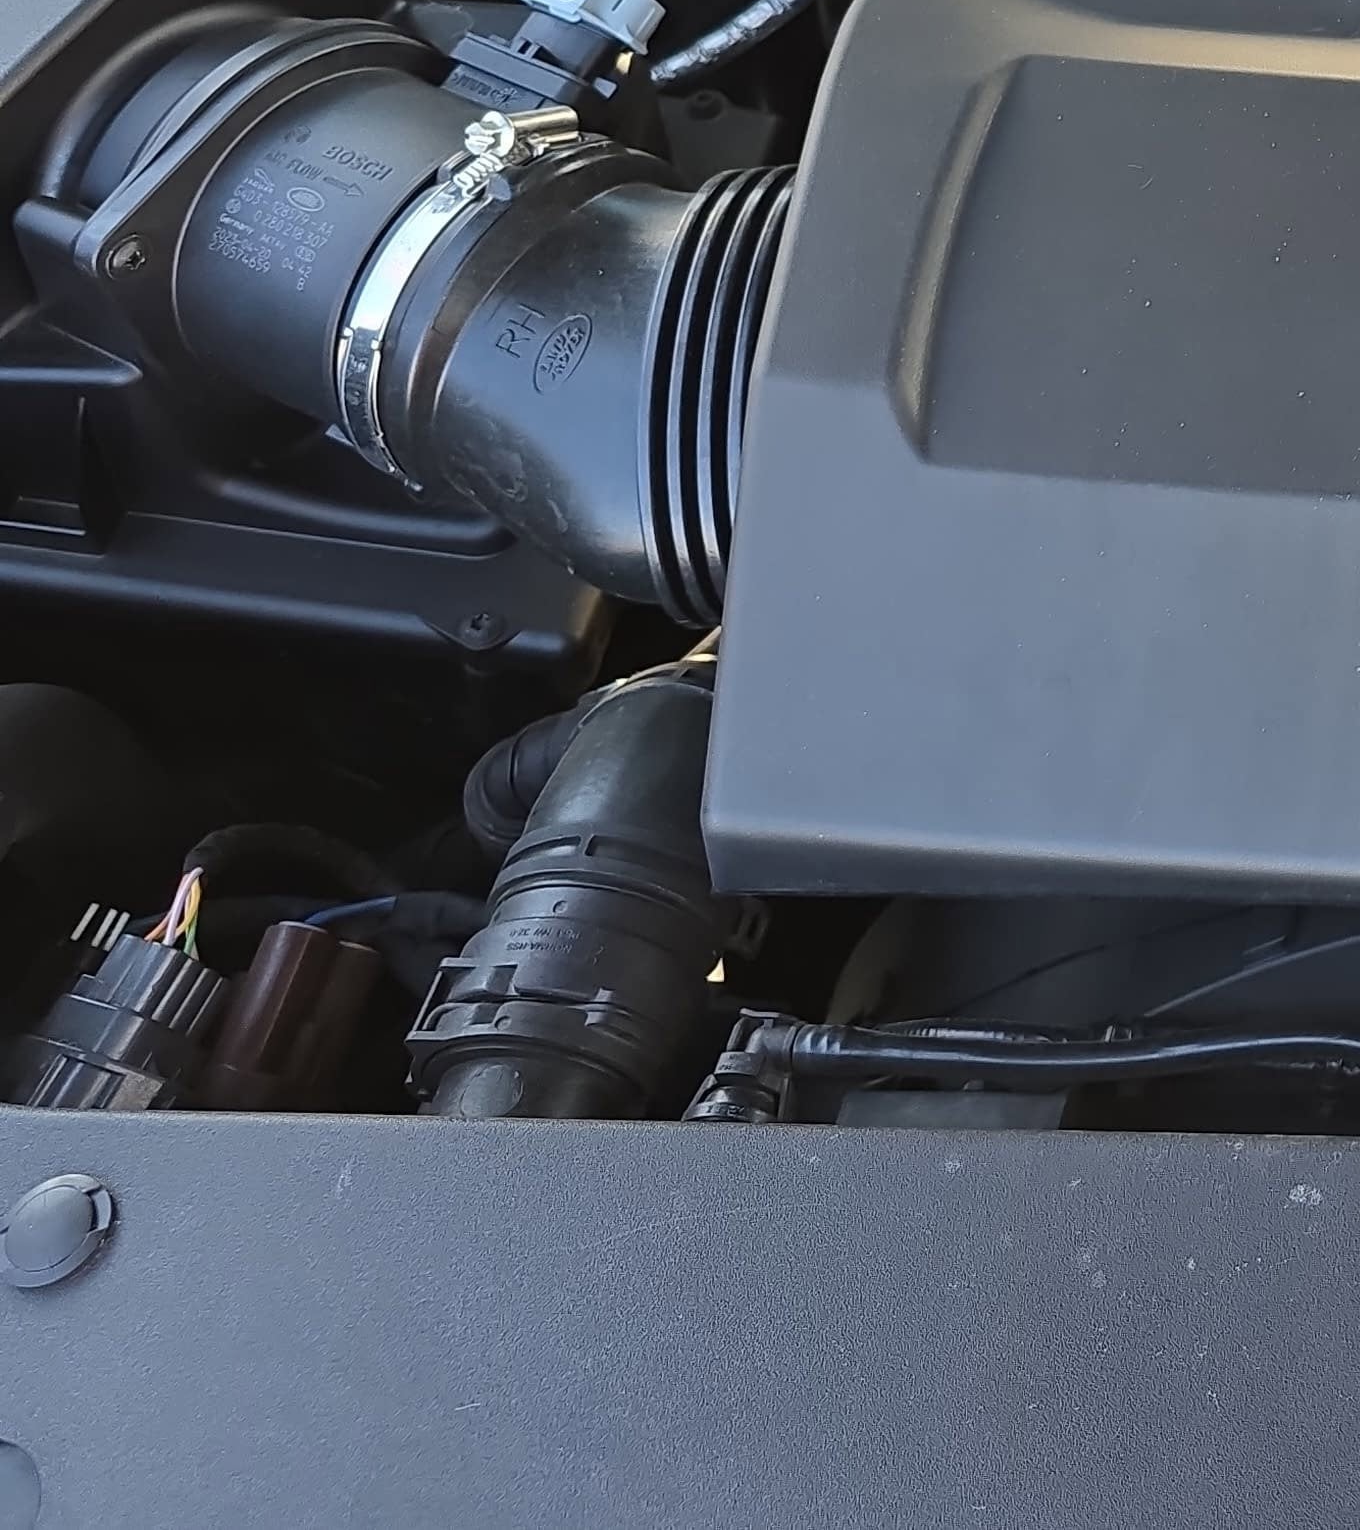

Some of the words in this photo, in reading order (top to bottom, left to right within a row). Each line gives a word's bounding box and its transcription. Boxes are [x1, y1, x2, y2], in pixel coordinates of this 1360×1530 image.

[286, 159, 324, 181] FLOW
[321, 145, 394, 181] BOSCH
[495, 303, 546, 358] RH
